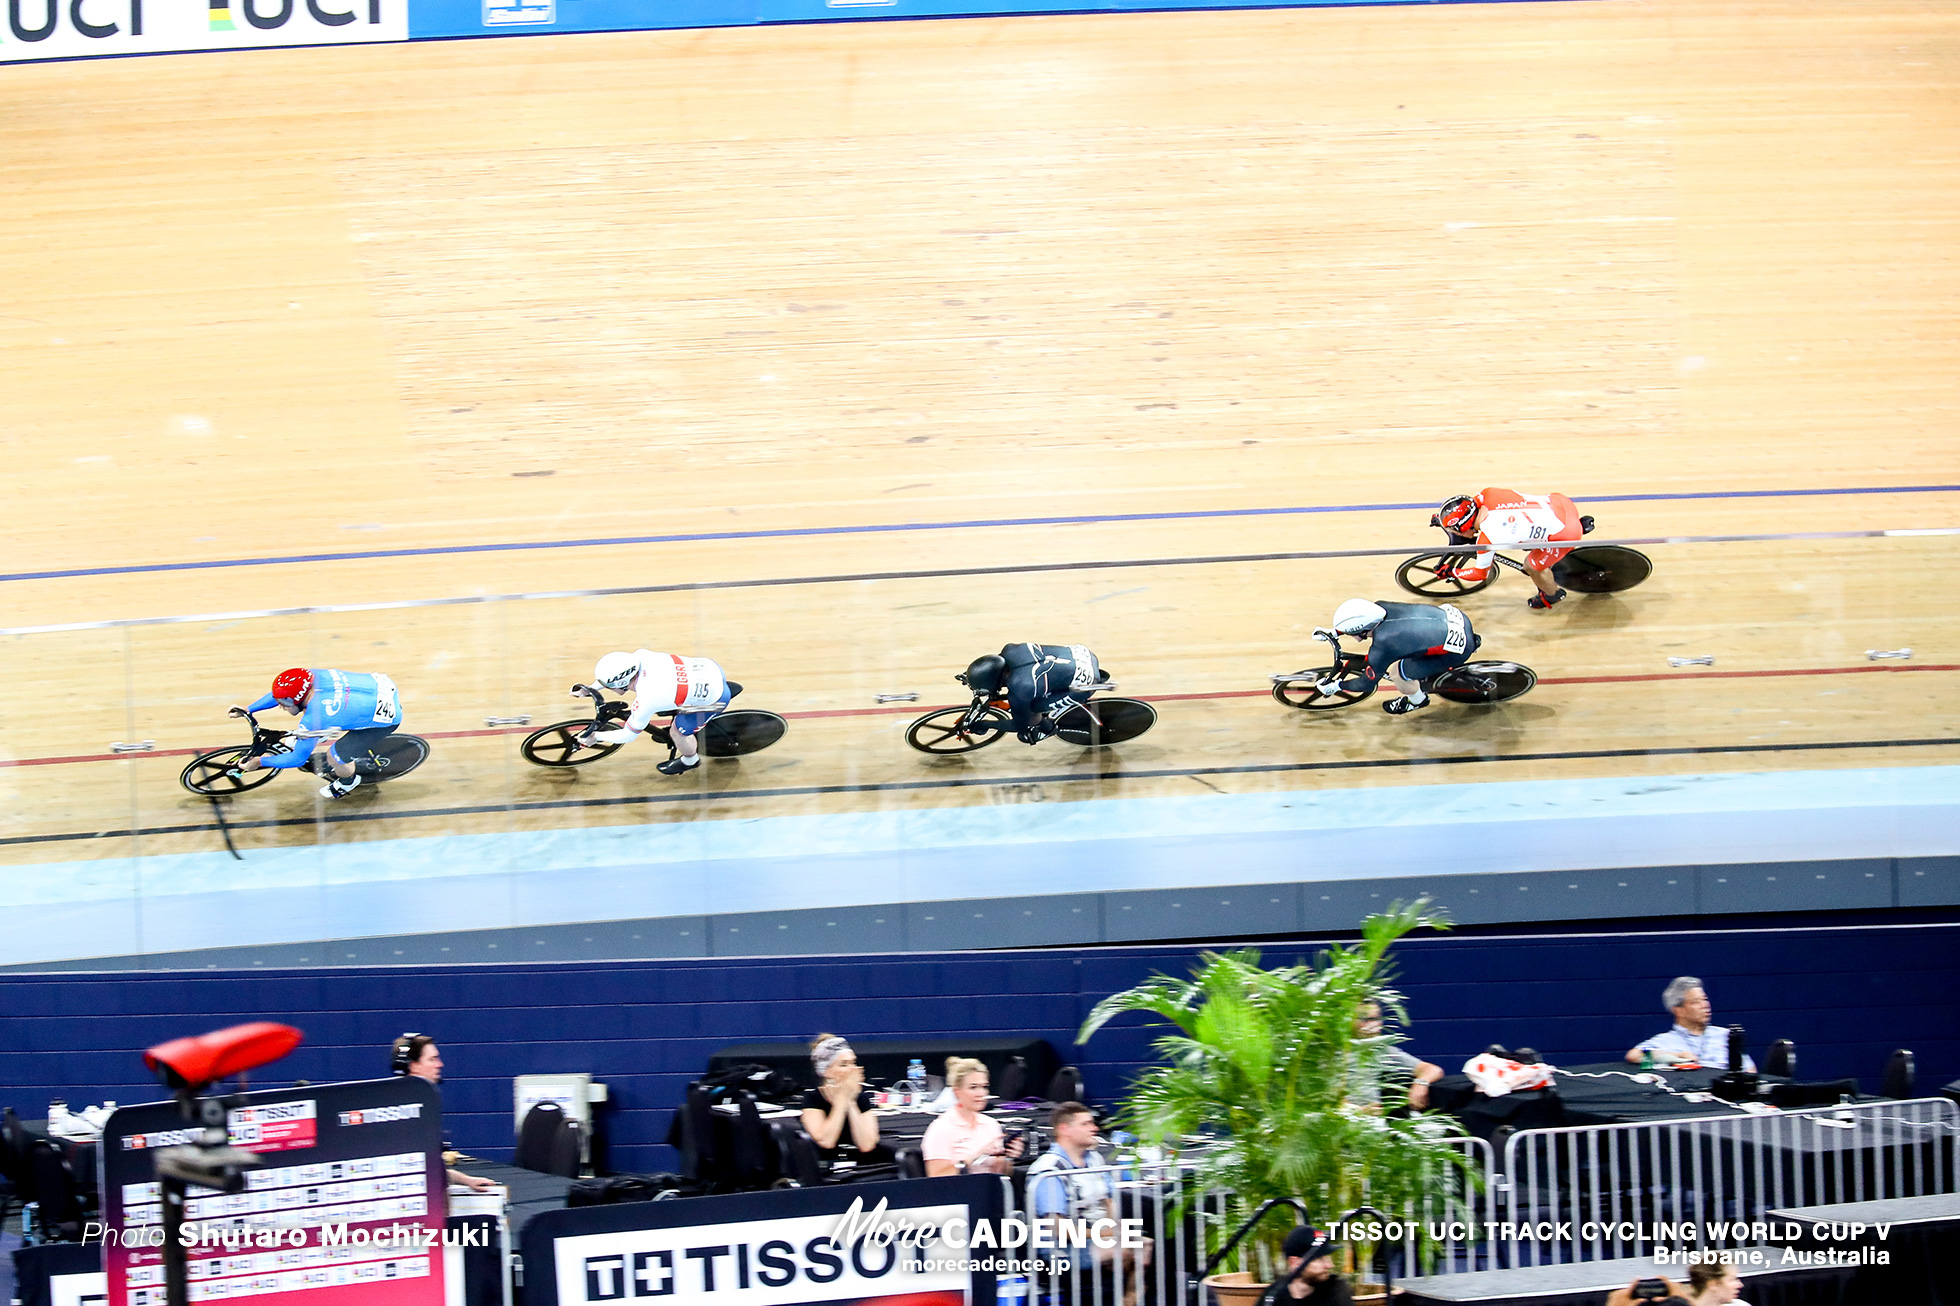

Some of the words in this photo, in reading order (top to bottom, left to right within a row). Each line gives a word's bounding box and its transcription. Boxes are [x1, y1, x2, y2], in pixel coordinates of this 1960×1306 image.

[1495, 501, 1528, 510] JAPAN
[1529, 526, 1547, 540] 181
[1446, 629, 1465, 648] 228
[607, 665, 637, 684] LAZER
[676, 665, 688, 684] GBR
